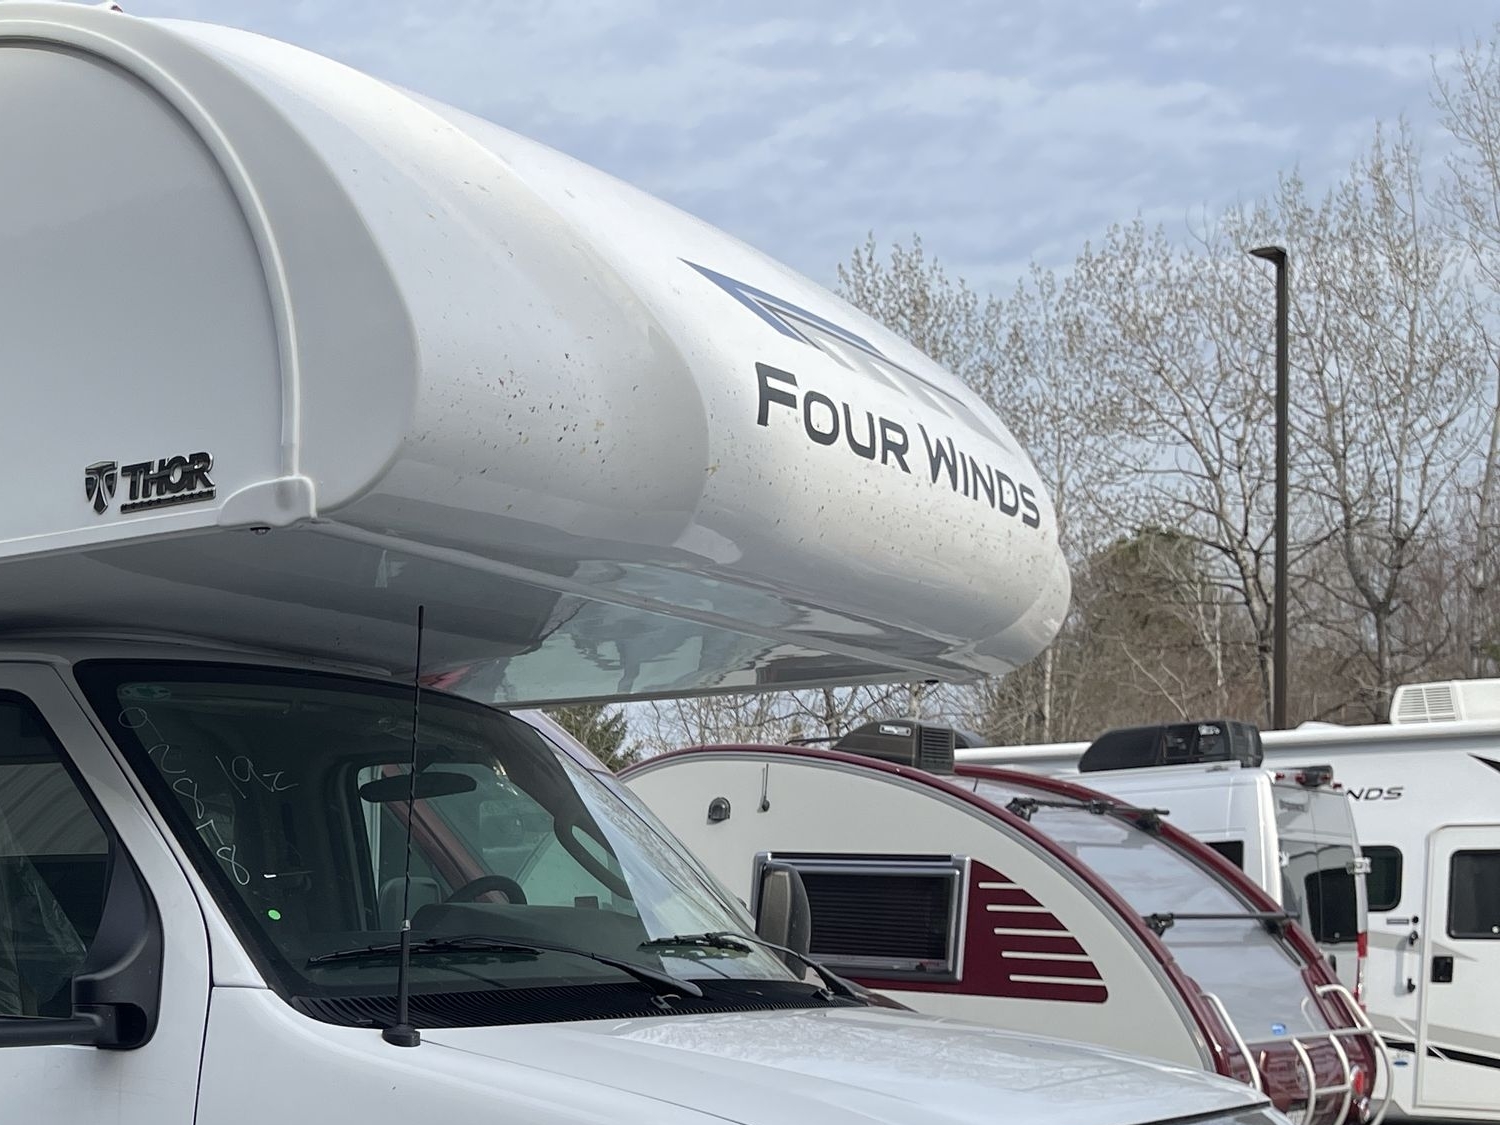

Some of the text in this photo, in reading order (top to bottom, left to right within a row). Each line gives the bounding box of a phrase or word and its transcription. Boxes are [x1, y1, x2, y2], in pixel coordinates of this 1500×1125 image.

[754, 361, 1041, 530] FOUR WINDS
[121, 451, 216, 501] THOR
[1346, 786, 1404, 801] NDS
